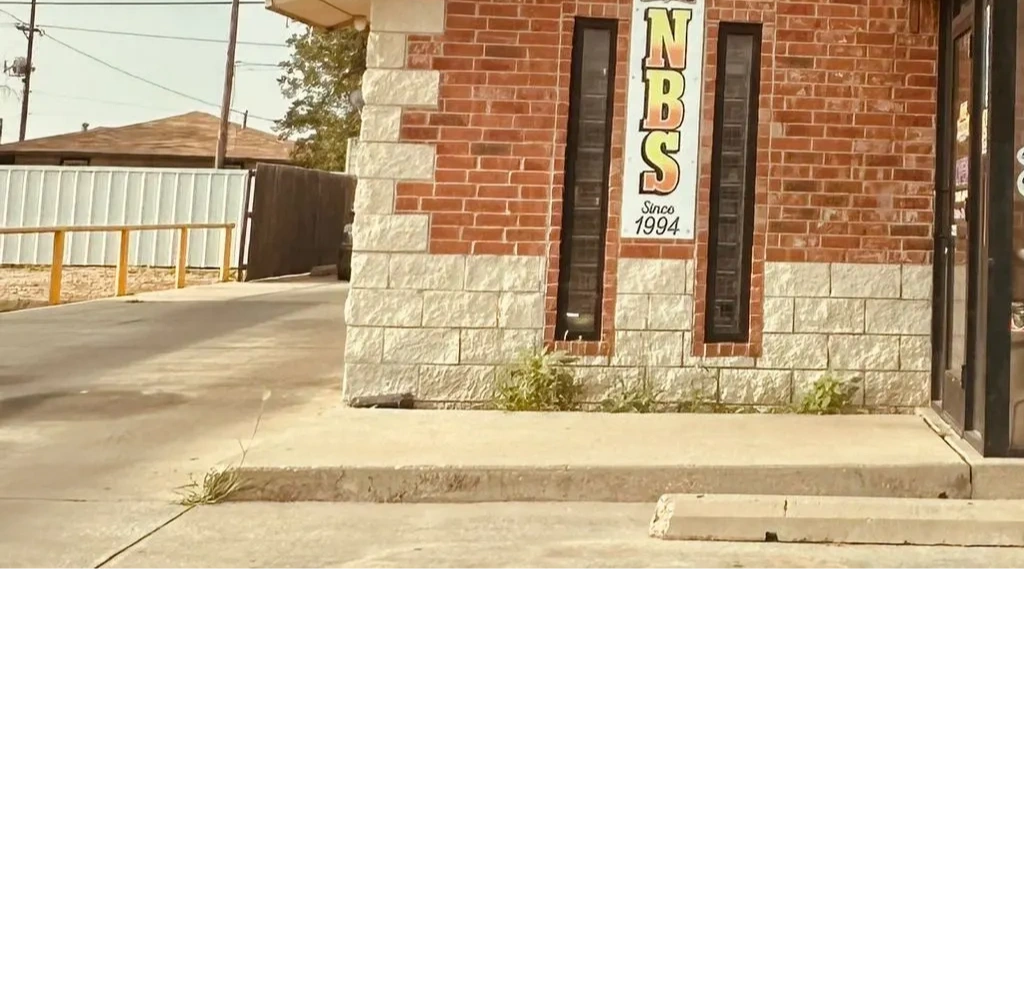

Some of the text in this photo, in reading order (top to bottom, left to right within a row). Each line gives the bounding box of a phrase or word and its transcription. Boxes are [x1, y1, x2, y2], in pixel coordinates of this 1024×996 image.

[639, 7, 692, 195] NBS
[641, 200, 675, 215] Since
[635, 216, 680, 236] 1994
